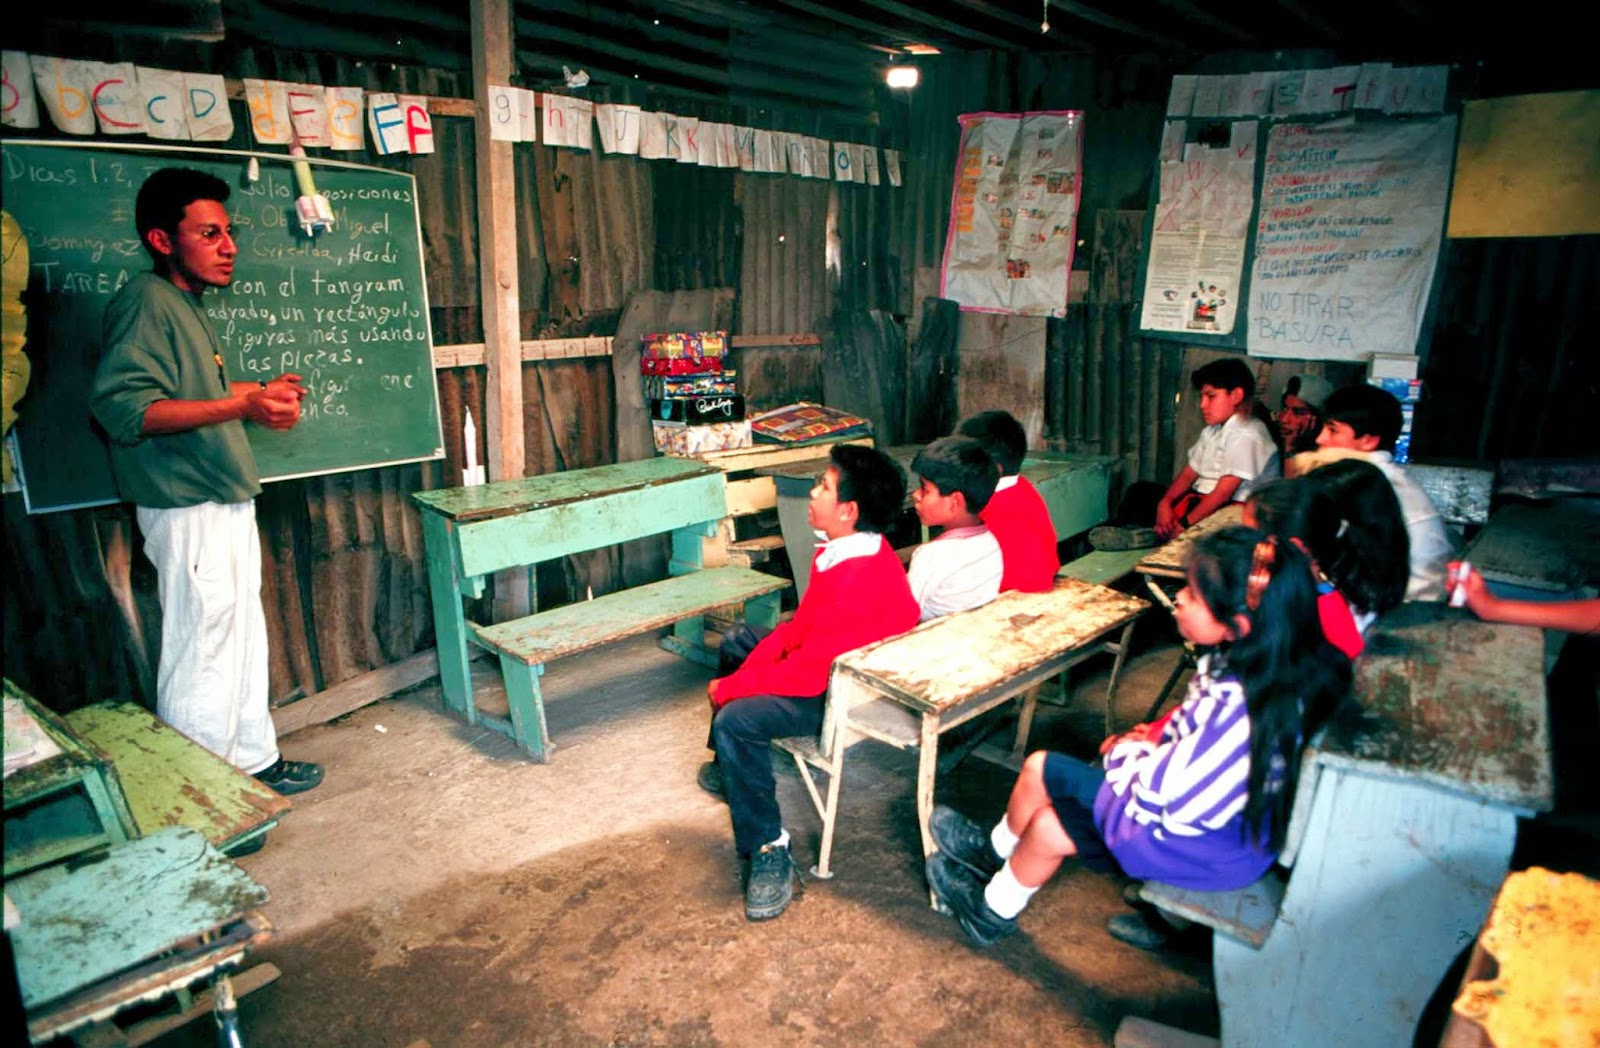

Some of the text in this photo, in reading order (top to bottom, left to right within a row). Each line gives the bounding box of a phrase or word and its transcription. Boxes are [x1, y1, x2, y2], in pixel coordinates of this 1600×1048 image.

[1332, 84, 1356, 112] T
[373, 104, 404, 154] F
[348, 242, 399, 264] Heidi
[233, 280, 266, 296] con
[279, 265, 295, 297] el
[207, 299, 277, 325] adrado,
[280, 306, 305, 322] un
[1259, 292, 1354, 322] NO TIRAR
[221, 319, 295, 353] figuras
[360, 319, 426, 342] usando
[1254, 317, 1352, 346] BASURA
[239, 350, 271, 373] las
